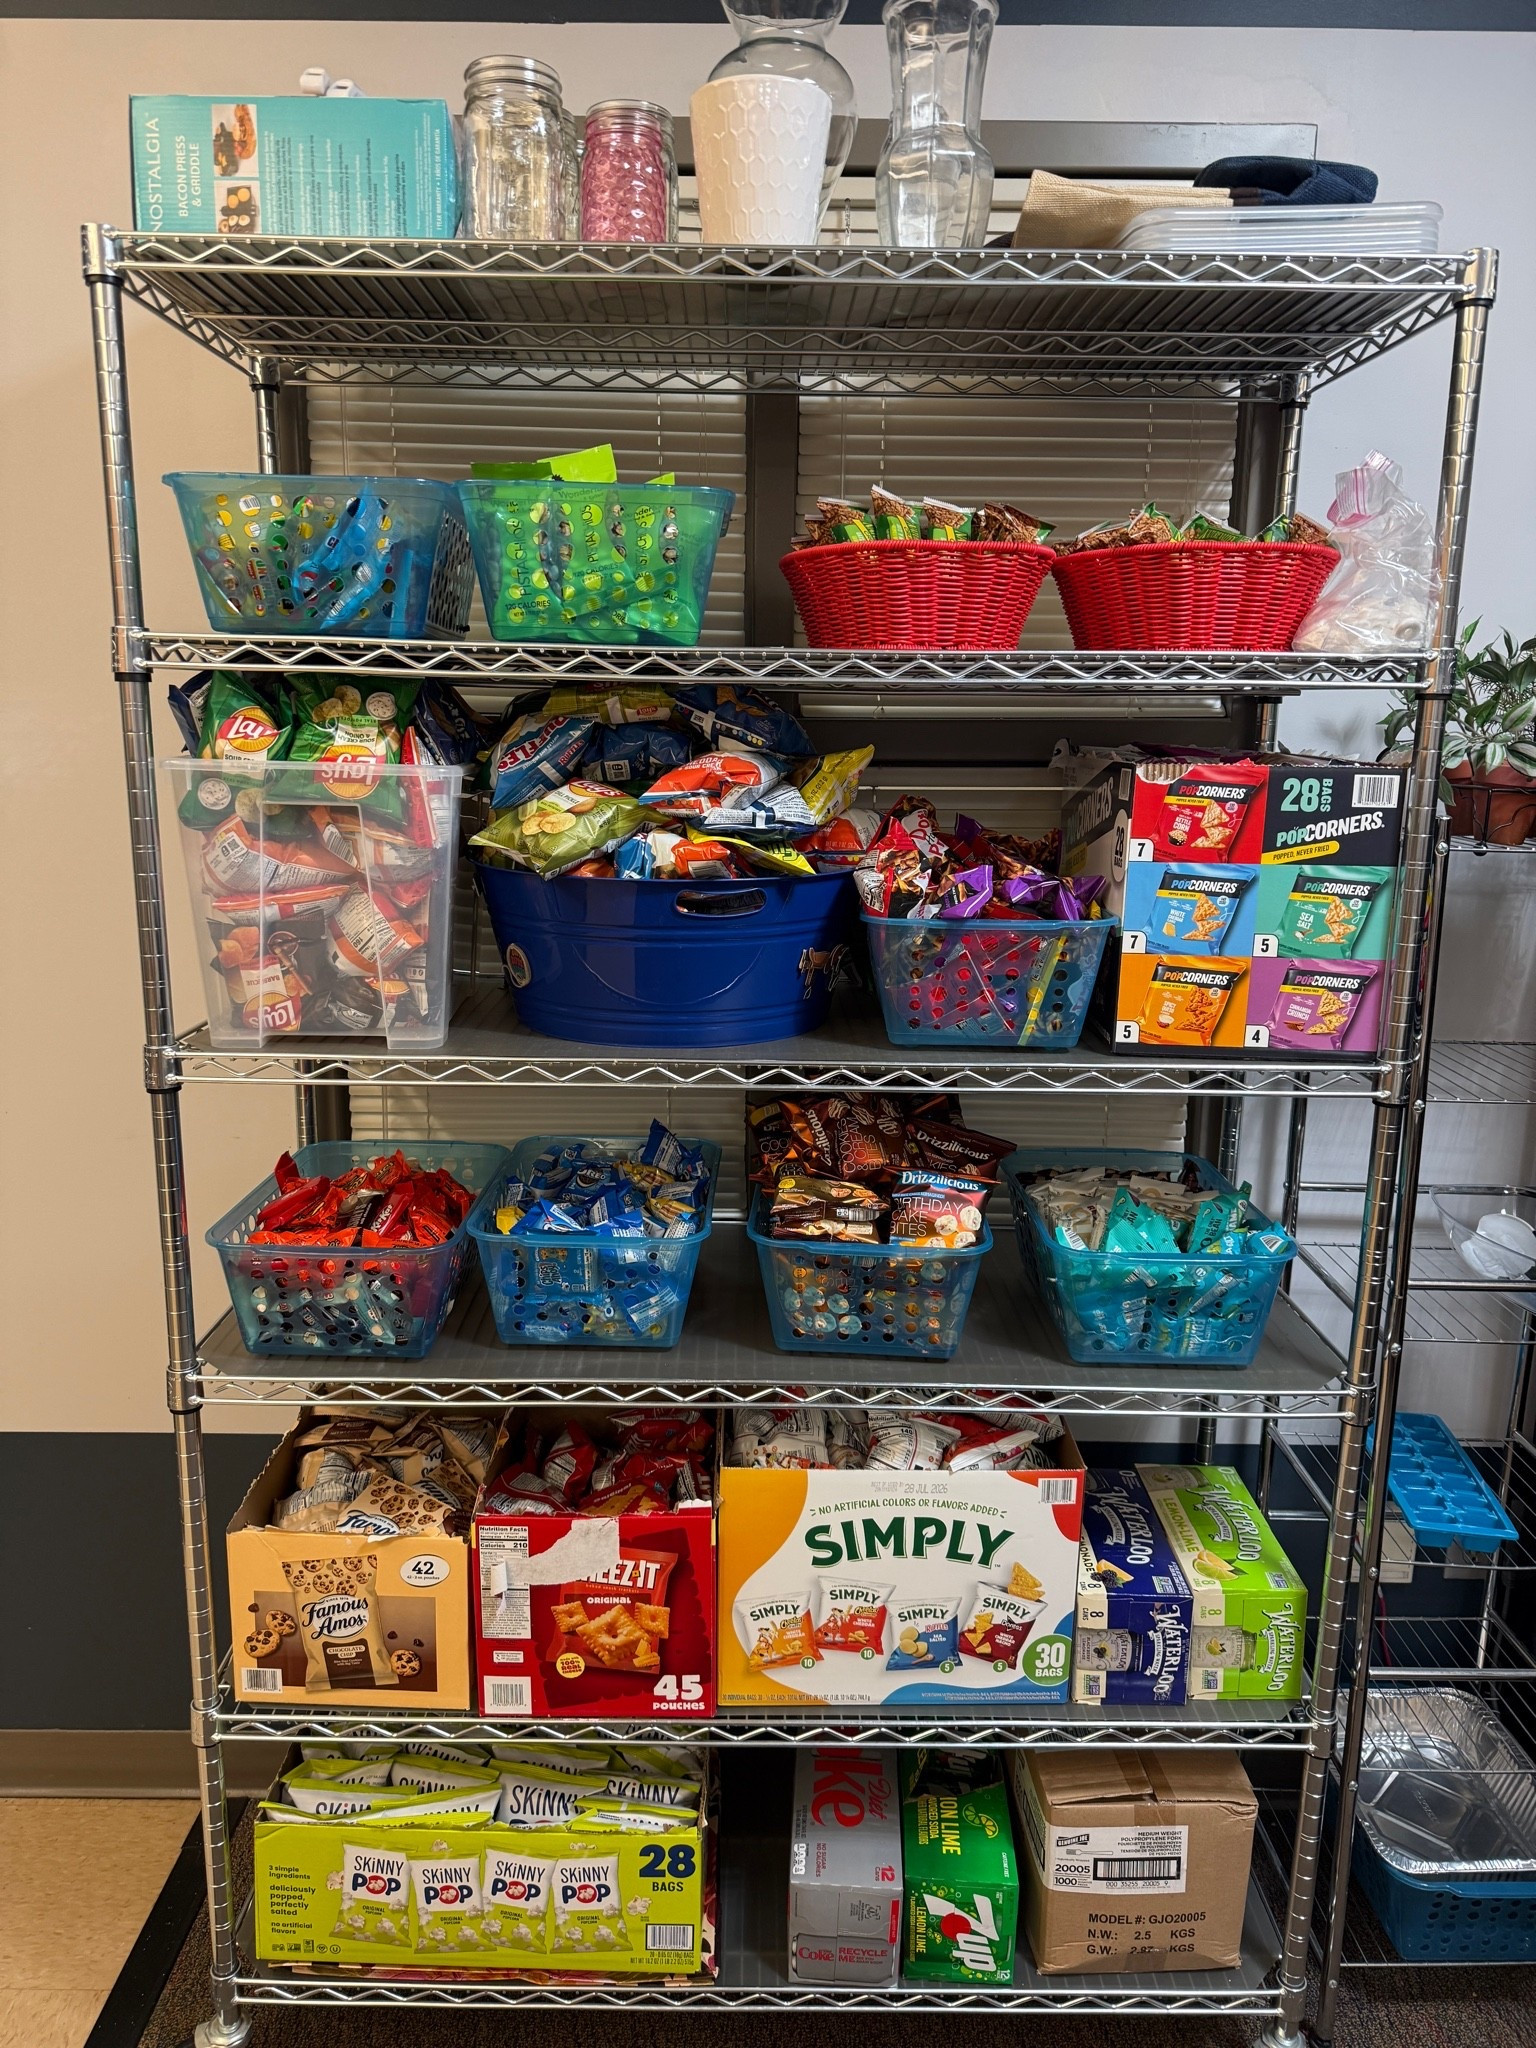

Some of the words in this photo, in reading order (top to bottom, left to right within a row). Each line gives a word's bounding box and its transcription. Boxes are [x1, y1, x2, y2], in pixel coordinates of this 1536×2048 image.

[175, 135, 187, 171] PRESS
[145, 117, 164, 231] NOSTALGIA
[189, 143, 201, 195] GRIDDLE
[177, 174, 188, 217] BACON
[191, 199, 202, 207] &
[517, 599, 551, 610] CALORIES
[1179, 784, 1246, 800] POPCORNERS
[1280, 777, 1321, 813] 28
[1320, 778, 1334, 812] BAGS
[1172, 822, 1190, 833] CORN
[1114, 825, 1125, 858] 28
[1137, 842, 1146, 857] 7
[1272, 852, 1295, 861] POPPED,
[1296, 847, 1313, 857] NEVER
[1314, 844, 1330, 854] FRIED
[1171, 879, 1238, 894] POPCORNERS
[1304, 882, 1371, 897] POPCORNERS
[1296, 920, 1313, 930] SALT
[1299, 912, 1314, 923] SEA
[1130, 935, 1139, 949] 7
[1261, 939, 1270, 953] 5
[1163, 971, 1230, 986] POPCORNERS
[1294, 975, 1361, 990] POPCORNERS
[1286, 1009, 1310, 1021] CRUNCH
[1123, 1025, 1132, 1039] 5
[1251, 1029, 1261, 1043] 4
[837, 1118, 857, 1173] COOKIES
[865, 1134, 881, 1171] BITES
[916, 1130, 991, 1161] Drizzilicious
[902, 1170, 980, 1191] Drizzilicious
[891, 1209, 928, 1224] CAKE
[1209, 1218, 1222, 1237] BEAN
[904, 1484, 914, 1494] 28
[916, 1484, 929, 1494] JUL
[931, 1483, 948, 1494] 2026
[818, 1505, 832, 1516] NO
[834, 1499, 881, 1513] ARTIFICIAL
[882, 1498, 916, 1507] COLORS
[919, 1498, 930, 1507] OR
[932, 1498, 968, 1511] FLAVORS
[970, 1503, 999, 1516] ADDED
[1085, 1486, 1154, 1565] WATERLOO
[1163, 1498, 1200, 1553] LEMON-LIME
[1186, 1483, 1262, 1561] WATERLOO
[804, 1516, 1015, 1570] SIMPLY
[412, 1561, 434, 1575] 42
[829, 1589, 881, 1605] SIMPLY
[301, 1598, 369, 1628] Famous
[750, 1604, 800, 1621] SIMPLY
[897, 1608, 949, 1622] SIMPLY
[982, 1597, 1031, 1619] SIMPLY
[1208, 1608, 1222, 1616] 8
[311, 1614, 365, 1640] Amos
[863, 1650, 872, 1658] 10
[1149, 1604, 1189, 1693] WATERLOO
[1262, 1602, 1301, 1691] WATERLOO
[803, 1658, 813, 1667] 10
[1035, 1642, 1066, 1668] 30
[944, 1663, 950, 1672] 5
[997, 1662, 1003, 1671] 5
[1035, 1668, 1063, 1677] BAGS
[653, 1674, 703, 1700] 45
[869, 1777, 892, 1820] Diet
[929, 1821, 939, 1839] SODA
[941, 1822, 962, 1855] LIME
[639, 1844, 696, 1878] 28
[1055, 1864, 1090, 1873] 20005
[881, 1865, 895, 1882] 12
[1055, 1877, 1077, 1885] 1000
[270, 1884, 316, 1895] deliciously
[352, 1873, 401, 1896] POP
[491, 1878, 542, 1902] POP
[652, 1881, 684, 1892] BAGS
[270, 1893, 306, 1901] popped,
[424, 1885, 473, 1905] POP
[562, 1883, 611, 1904] POP
[270, 1901, 309, 1910] perfectly
[270, 1908, 298, 1916] salted
[362, 1904, 386, 1913] ORIGINAL
[500, 1910, 523, 1919] ORIGINAL
[916, 1906, 927, 1933] LEMON
[1088, 1913, 1133, 1925] MODEL
[1134, 1915, 1146, 1925] #:
[1148, 1911, 1206, 1925] GJO20005
[271, 1927, 297, 1935] flavors
[282, 1921, 313, 1929] artificial
[923, 1893, 1000, 1972] 7up
[1087, 1929, 1118, 1940] N.W.:
[1134, 1931, 1151, 1940] 2.5
[1170, 1928, 1196, 1939] KGS
[916, 1934, 927, 1954] LIME
[1087, 1944, 1117, 1955] G.W.:
[1169, 1943, 1195, 1953] KGS
[798, 1947, 835, 1962] Coke
[838, 1947, 888, 1957] RECYCLE
[838, 1955, 856, 1963] ME
[1000, 1969, 1011, 1979] 12
